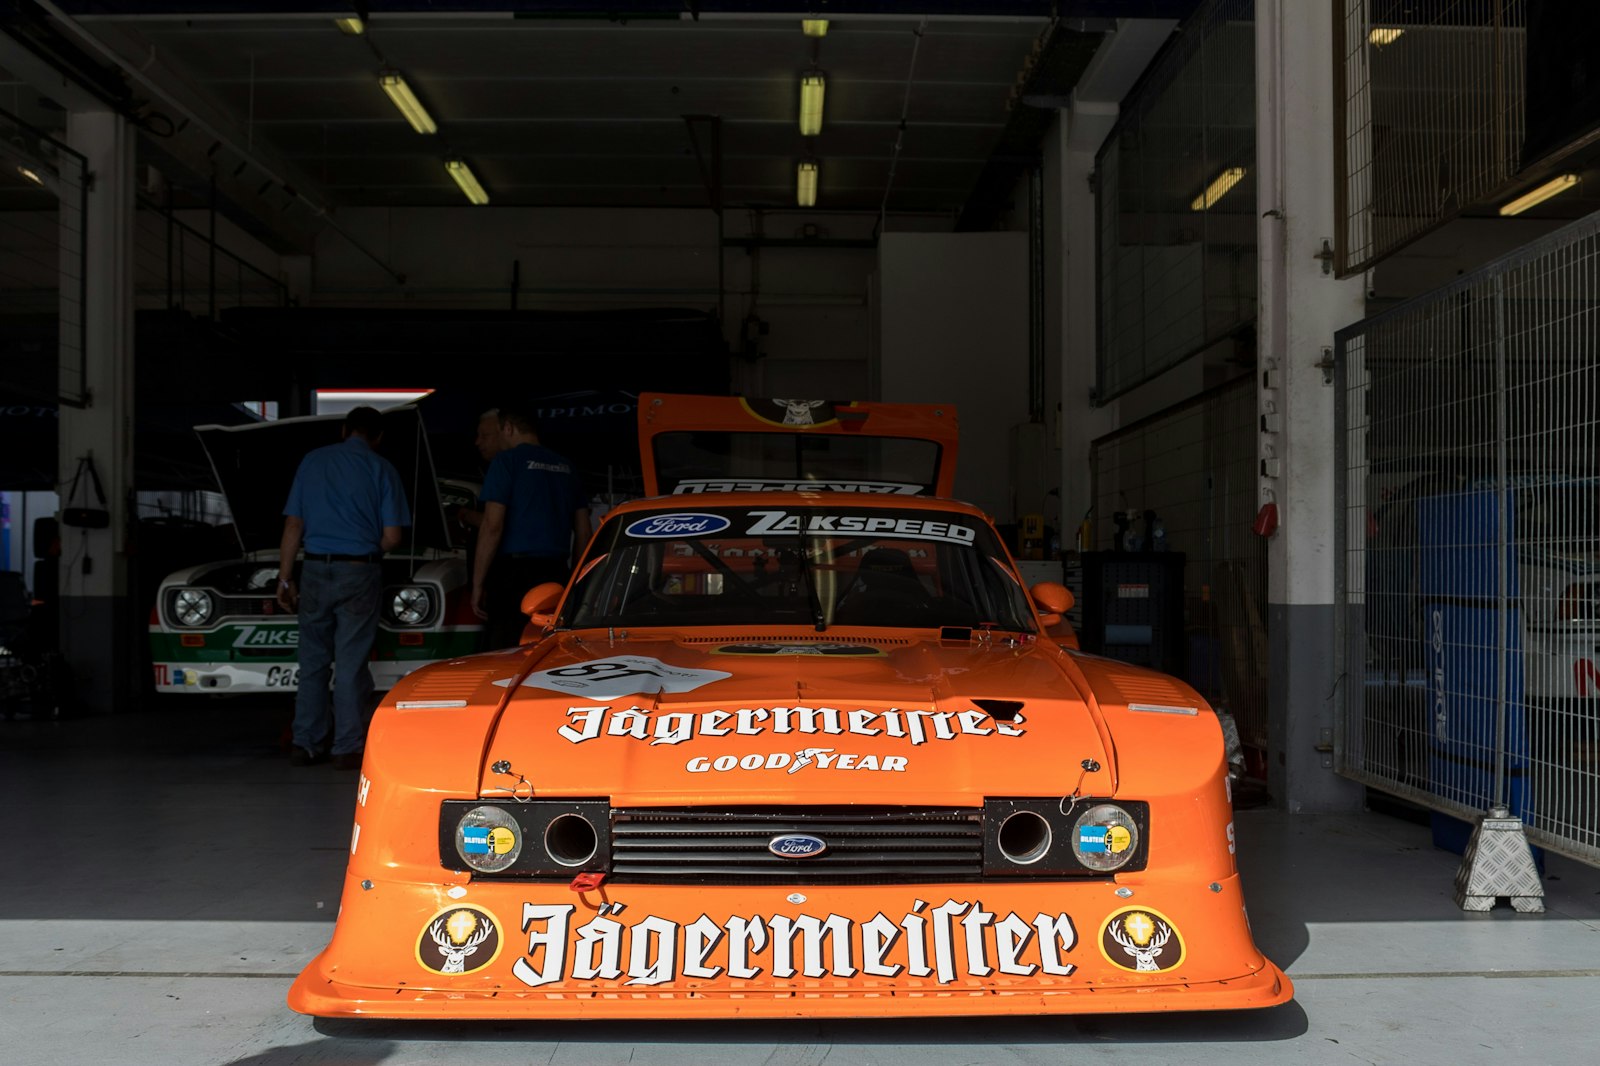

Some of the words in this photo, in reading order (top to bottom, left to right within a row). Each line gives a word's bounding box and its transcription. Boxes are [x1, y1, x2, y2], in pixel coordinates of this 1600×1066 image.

[745, 511, 975, 547] ZAKSPEED
[685, 748, 908, 775] GOODYEAR
[512, 898, 1079, 987] Jägermeister
